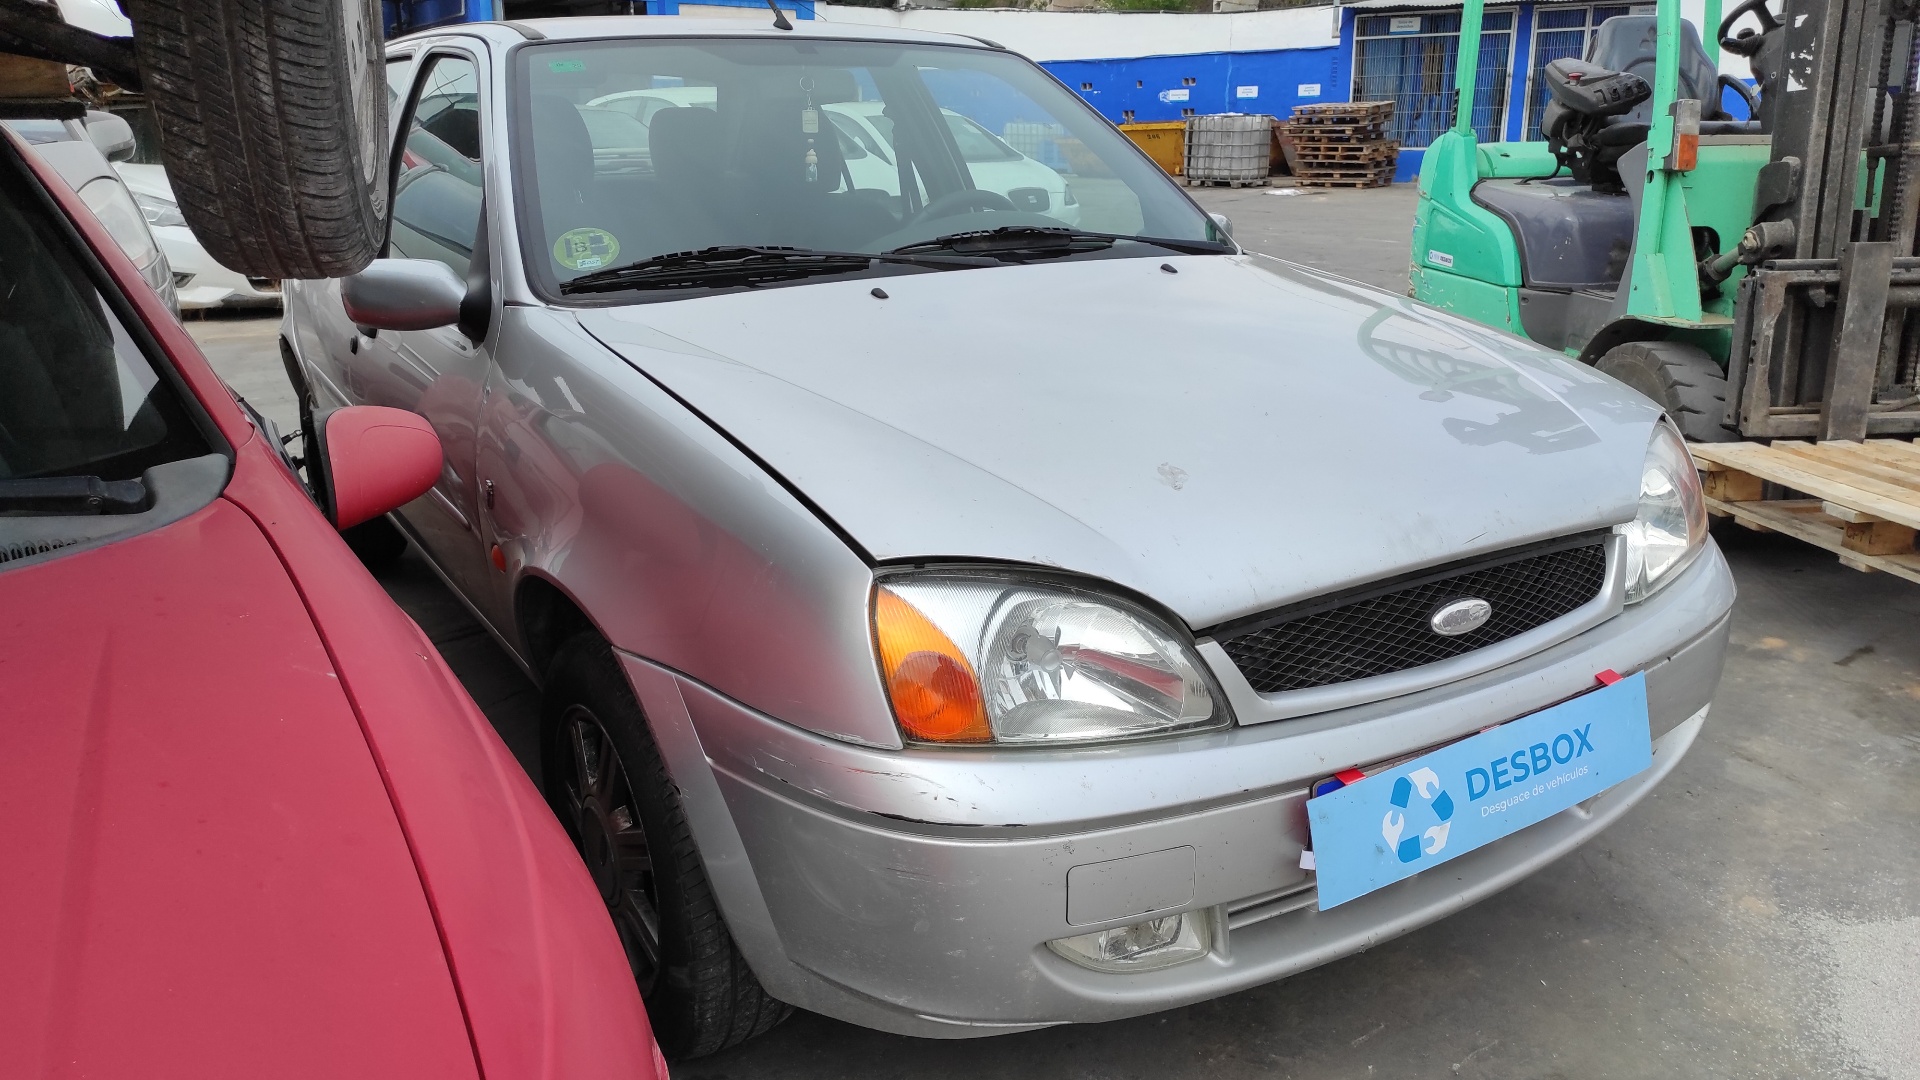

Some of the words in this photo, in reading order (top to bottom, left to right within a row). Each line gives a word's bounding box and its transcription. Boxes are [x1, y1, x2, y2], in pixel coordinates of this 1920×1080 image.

[1465, 722, 1594, 802] DESBOX
[1481, 790, 1530, 817] Desguace
[1532, 784, 1545, 796] de
[1545, 765, 1589, 791] vehículos
